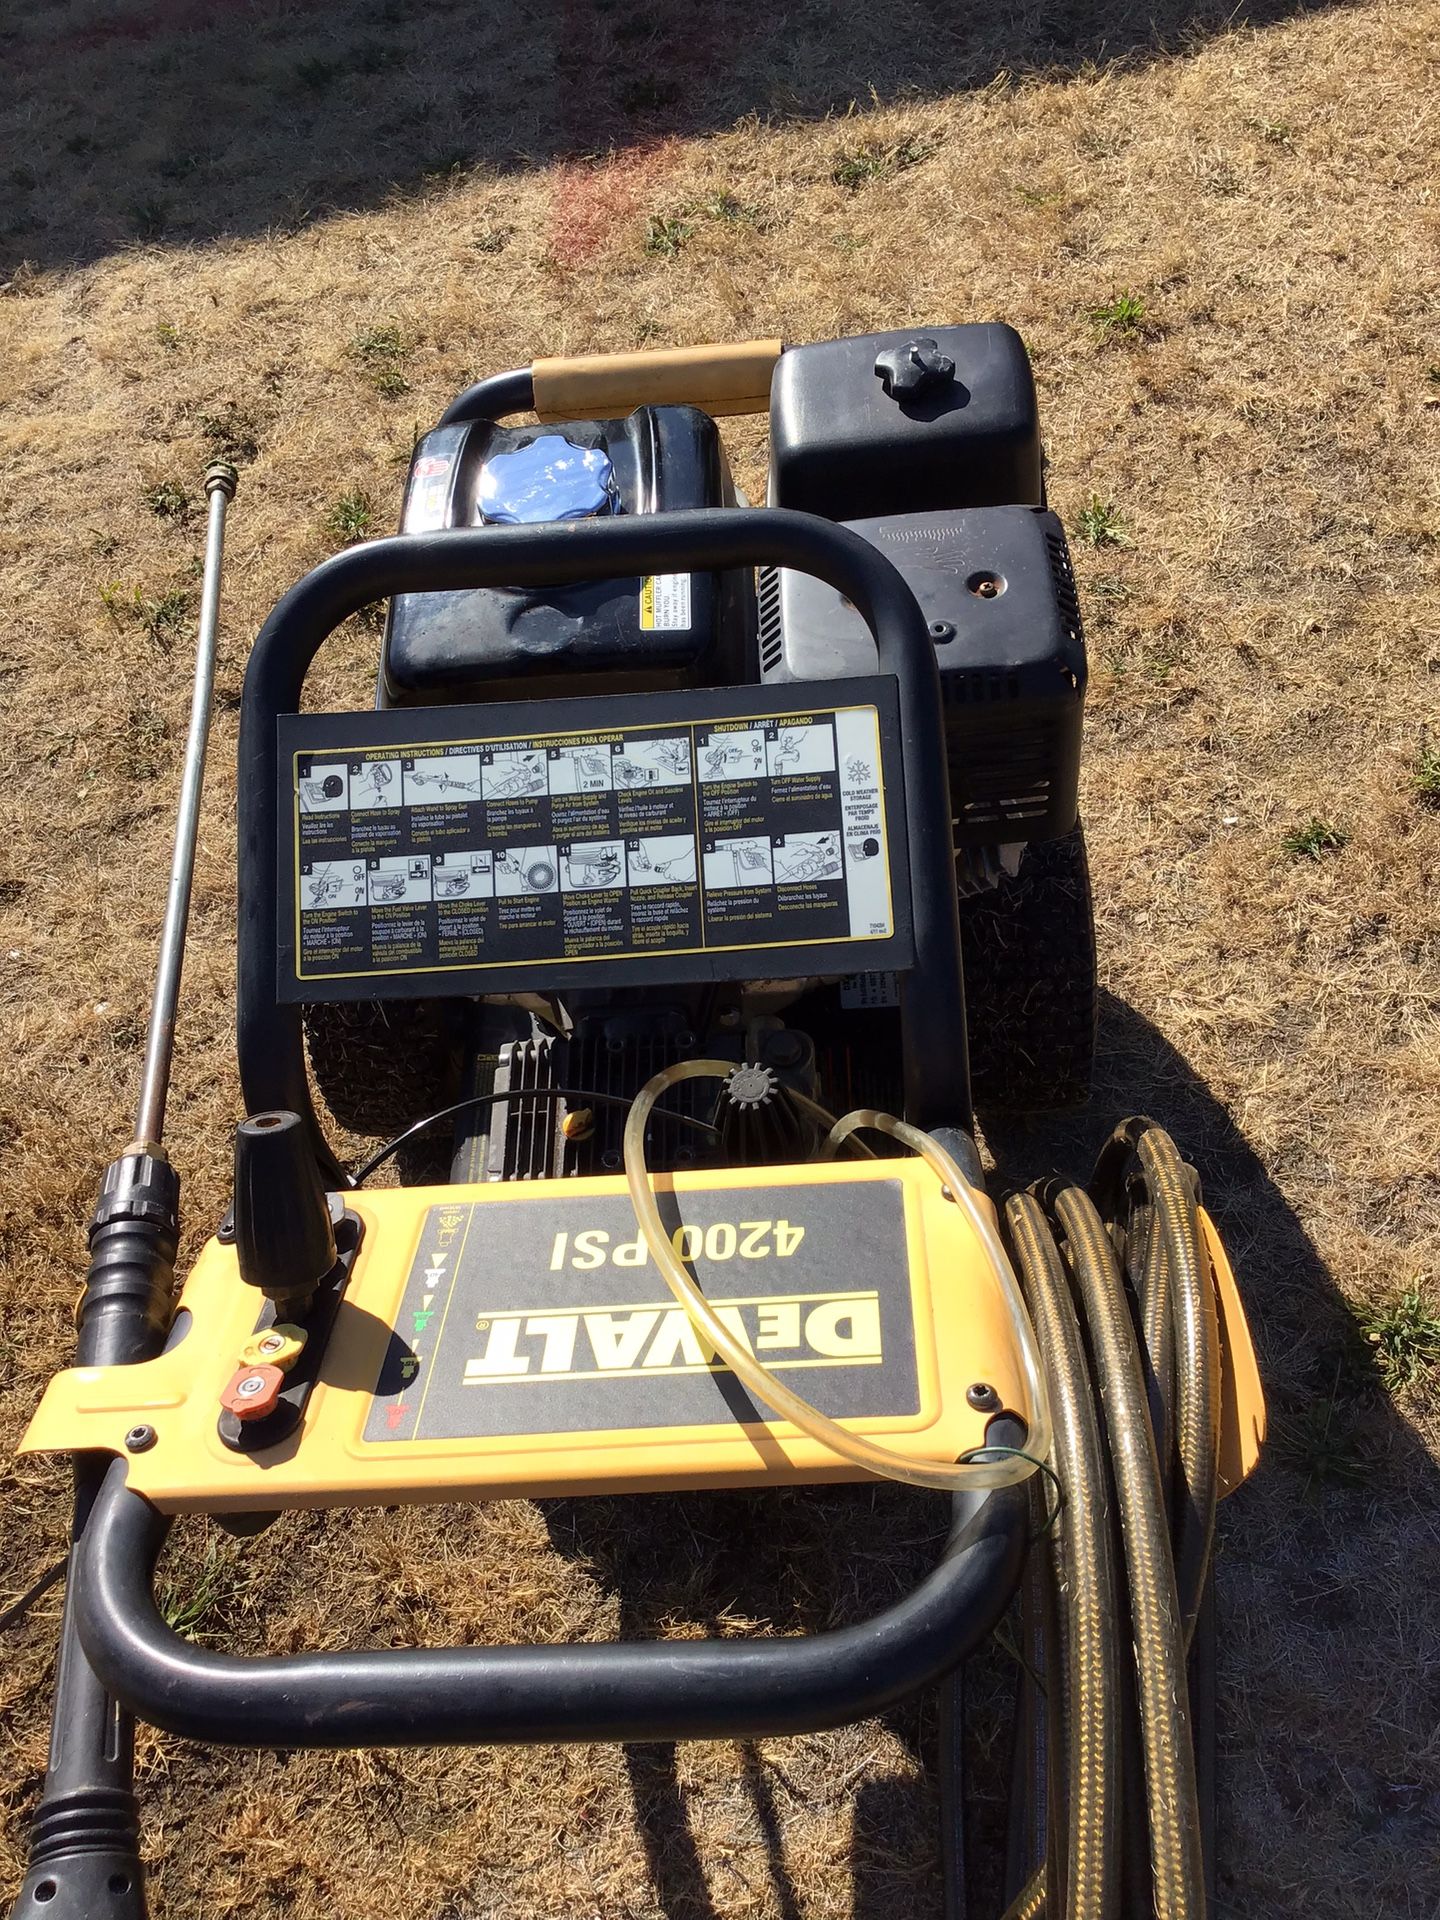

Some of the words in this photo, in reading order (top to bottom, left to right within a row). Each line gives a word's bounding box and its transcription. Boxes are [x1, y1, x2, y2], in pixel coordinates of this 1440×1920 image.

[671, 615, 679, 627] Stay
[714, 723, 748, 732] SHUTDOWN
[779, 717, 812, 726] APAGANDO
[365, 751, 399, 761] OPERATING
[400, 748, 443, 758] INSTRUCTIONS
[449, 745, 483, 754] DIRECTIVES
[532, 737, 580, 747] INSTRUCCIONES
[581, 736, 597, 744] PARA
[598, 733, 623, 742] OPERAR
[549, 750, 556, 758] 5
[589, 779, 603, 787] MIN
[353, 873, 364, 881] OFF
[672, 1220, 805, 1261] 4200
[549, 1228, 649, 1271] PSI
